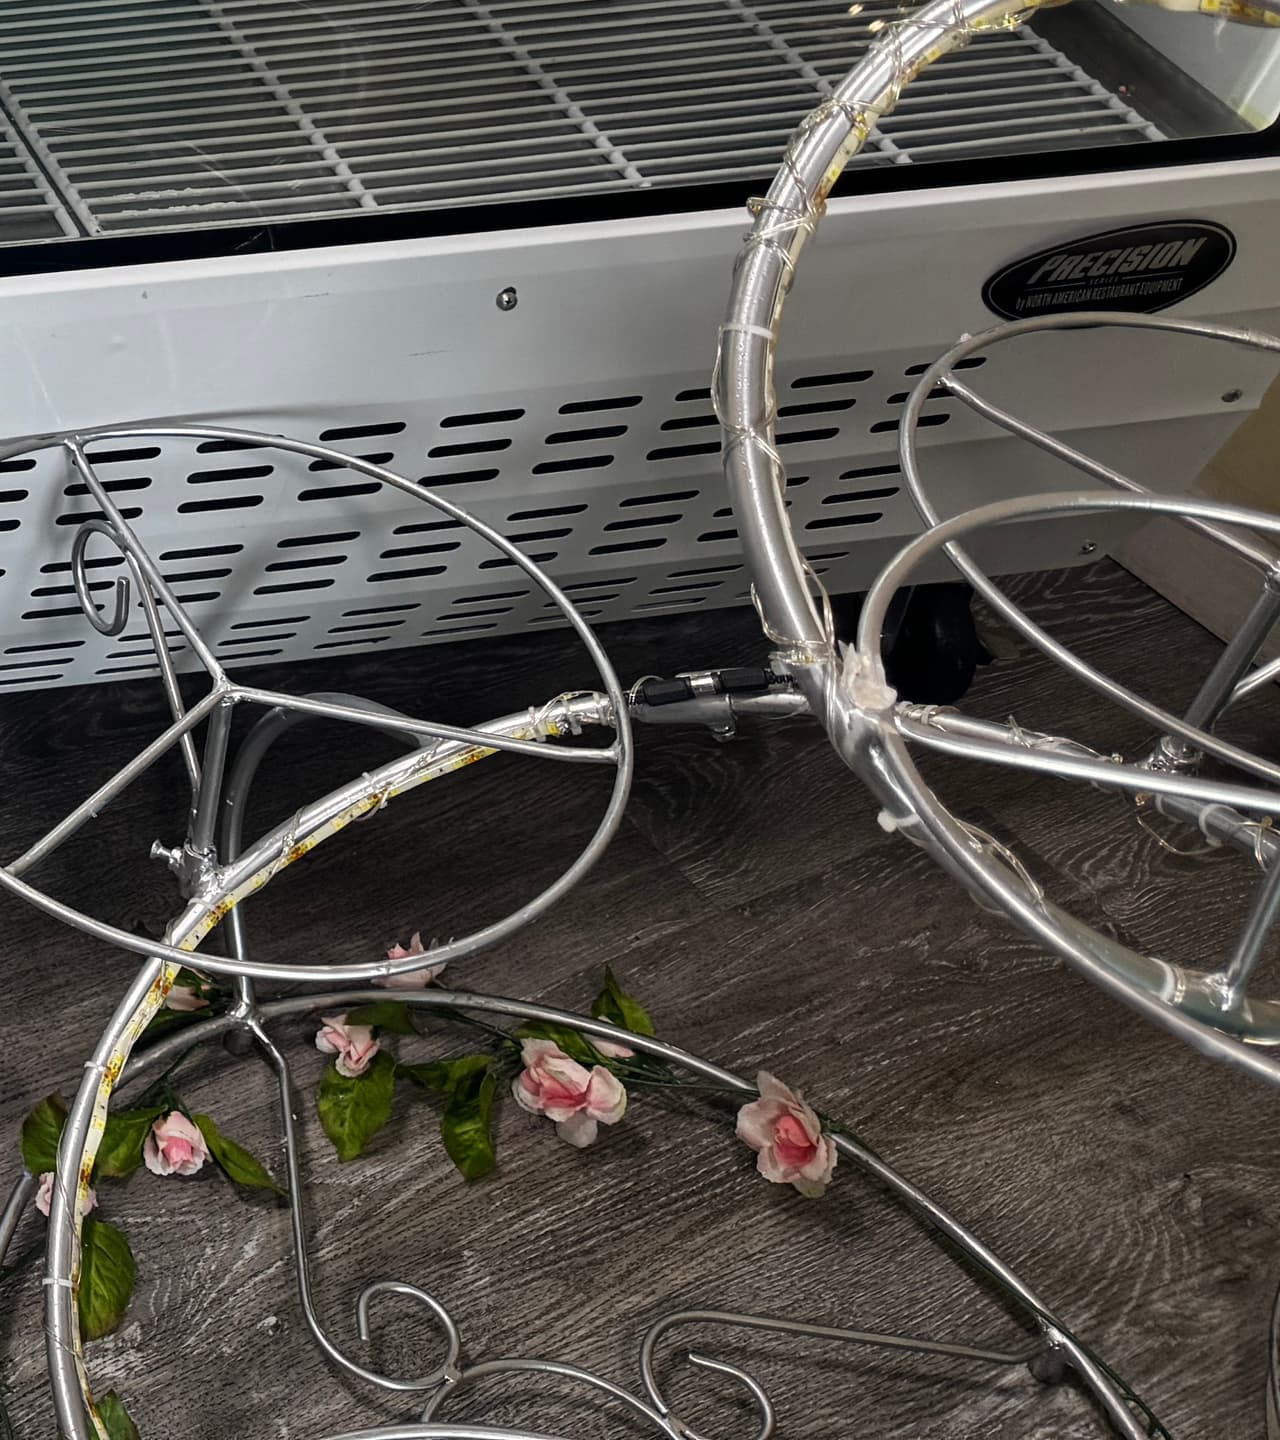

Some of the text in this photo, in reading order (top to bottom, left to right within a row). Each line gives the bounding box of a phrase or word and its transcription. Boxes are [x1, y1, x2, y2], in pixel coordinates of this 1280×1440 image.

[1027, 237, 1207, 284] PRECISION
[1016, 277, 1183, 311] by NORTH AMERICAN RESTAURANT EQUIPMENT
